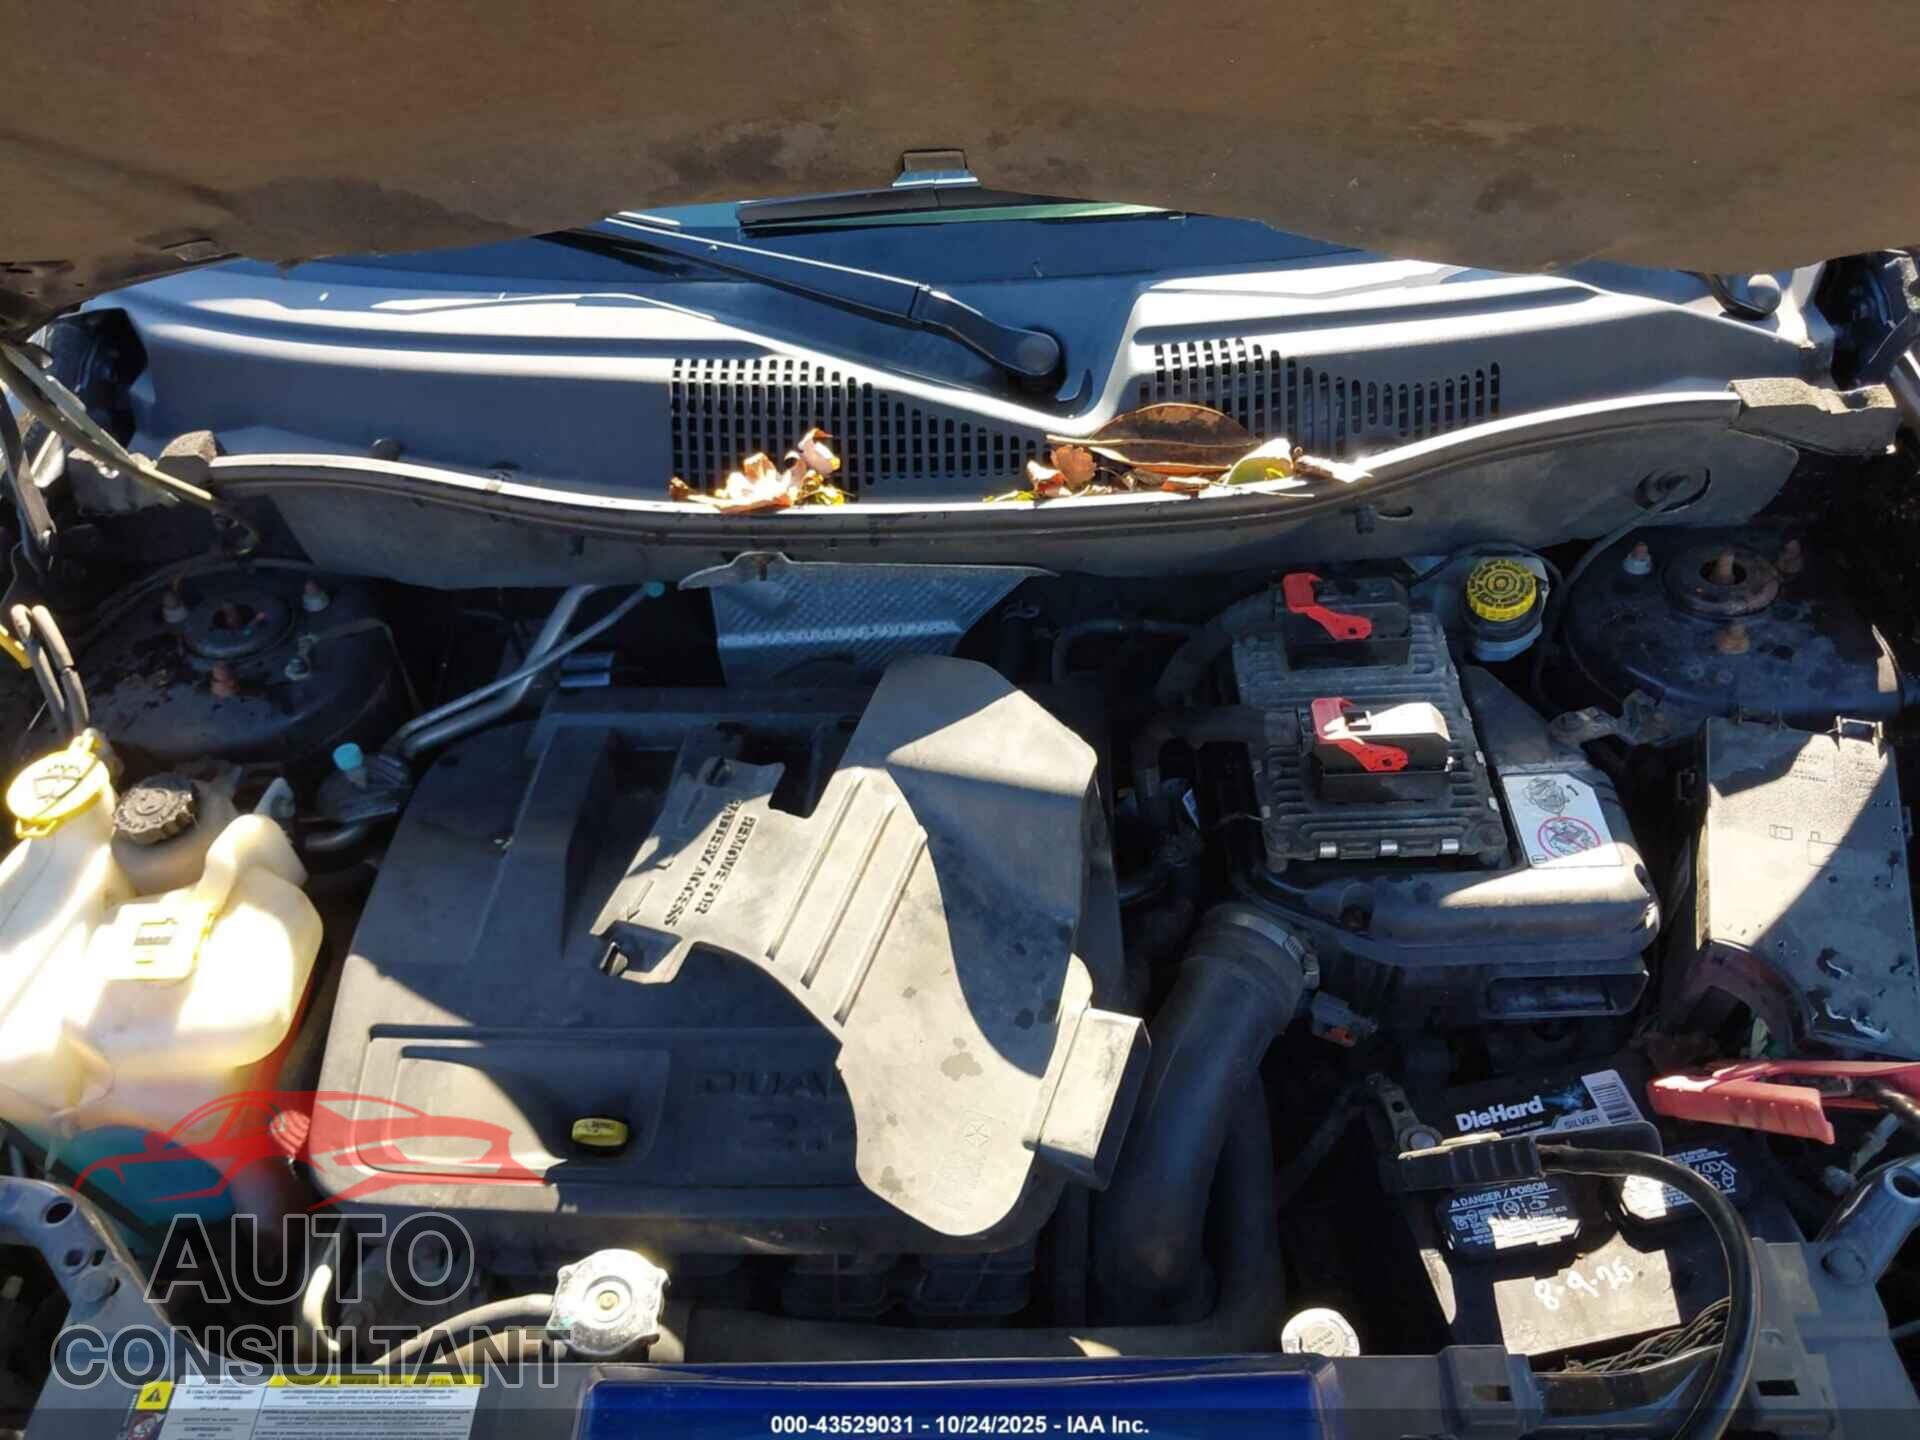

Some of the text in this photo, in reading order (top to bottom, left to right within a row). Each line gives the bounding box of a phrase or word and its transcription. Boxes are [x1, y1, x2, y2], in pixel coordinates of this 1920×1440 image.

[695, 816, 757, 915] REMOVE FOR
[664, 866, 705, 927] ACCESS
[1455, 1095, 1546, 1132] DieHard
[1563, 1114, 1601, 1130] SILVER
[1460, 1191, 1502, 1206] DANGER
[1510, 1181, 1548, 1196] POISON
